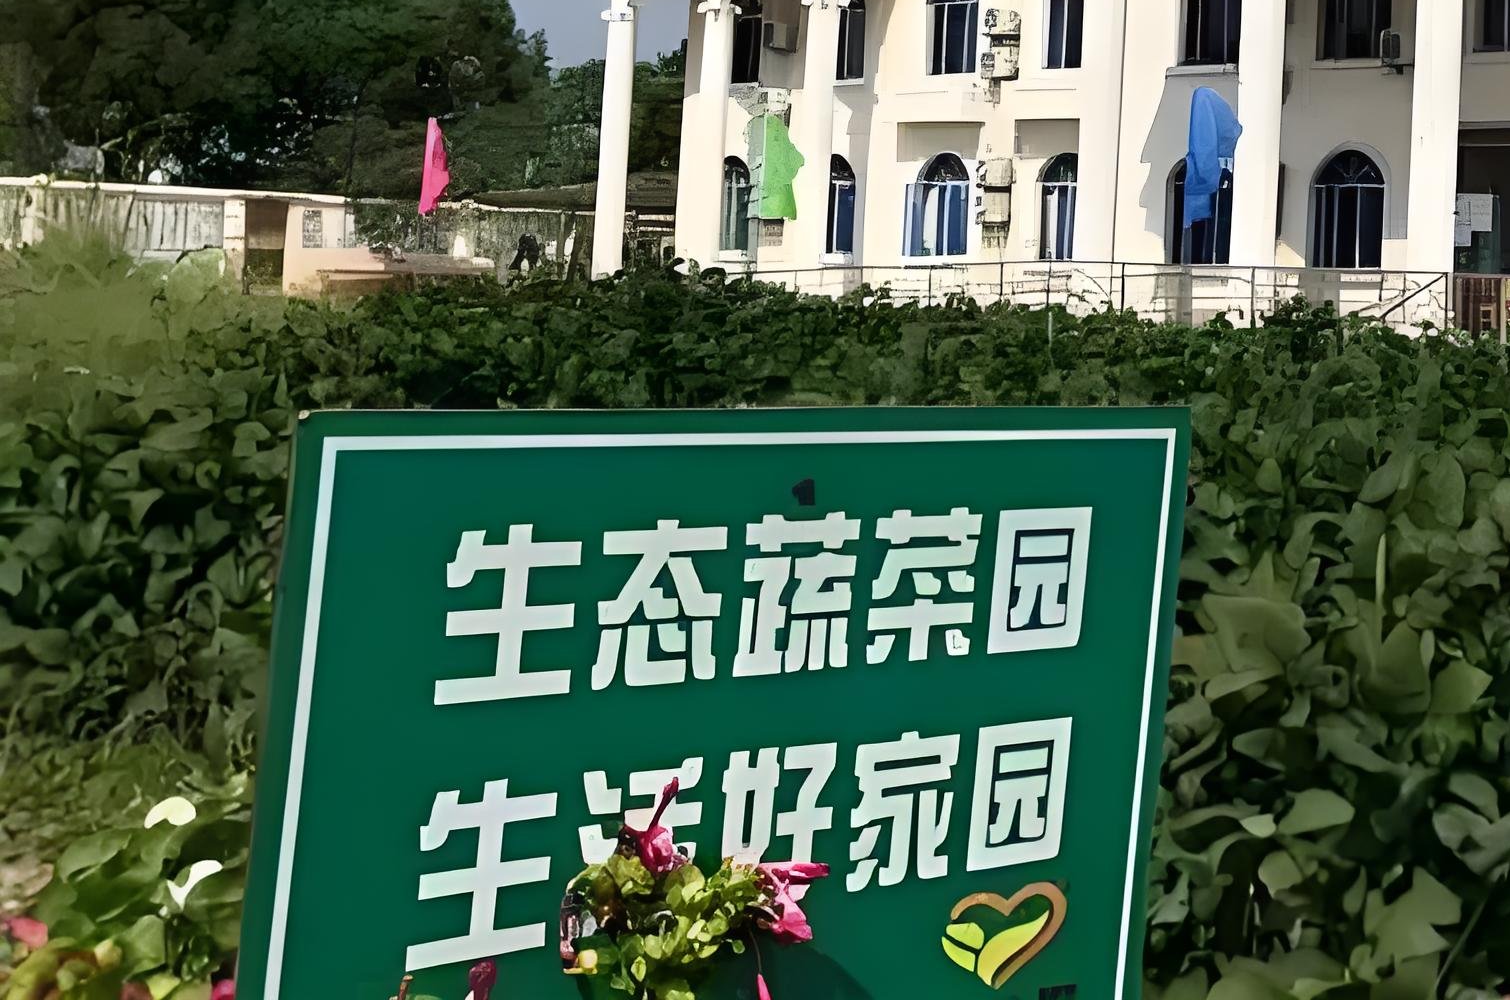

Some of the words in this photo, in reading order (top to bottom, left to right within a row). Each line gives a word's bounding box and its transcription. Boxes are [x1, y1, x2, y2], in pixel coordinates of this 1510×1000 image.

[434, 507, 1092, 705] 生态蔬菜园
